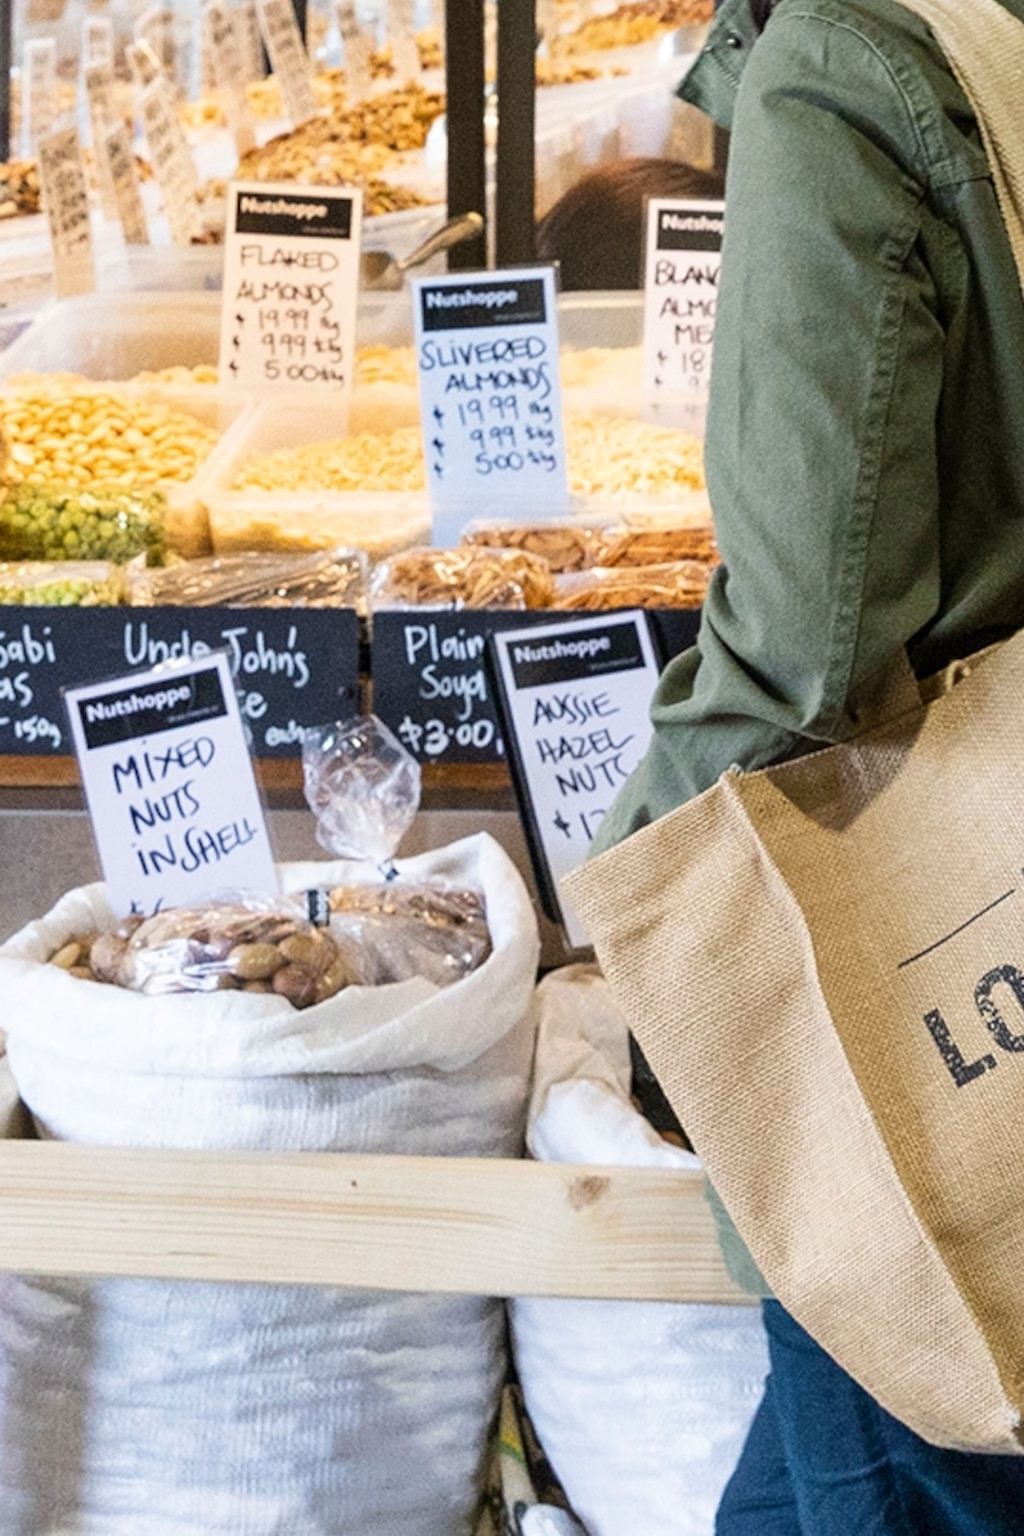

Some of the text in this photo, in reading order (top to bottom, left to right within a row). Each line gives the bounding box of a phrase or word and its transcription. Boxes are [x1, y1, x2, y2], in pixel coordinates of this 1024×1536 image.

[240, 195, 328, 220] Nutshoppe
[240, 244, 340, 272] FLAKED
[236, 280, 334, 313] ALMONDS
[425, 288, 518, 309] Nutshoppe
[419, 335, 547, 371] SLIVERED
[444, 361, 552, 400] ALMONDS
[221, 625, 310, 689] John's
[404, 623, 485, 664] Plain
[513, 636, 612, 663] Nutshoppe
[86, 684, 192, 723] Nutshoppe
[419, 663, 488, 722] Soya
[531, 692, 622, 727] AUSSIE
[536, 728, 635, 764] HAZEL
[112, 737, 216, 794] MIXED
[128, 779, 201, 836] NUTS
